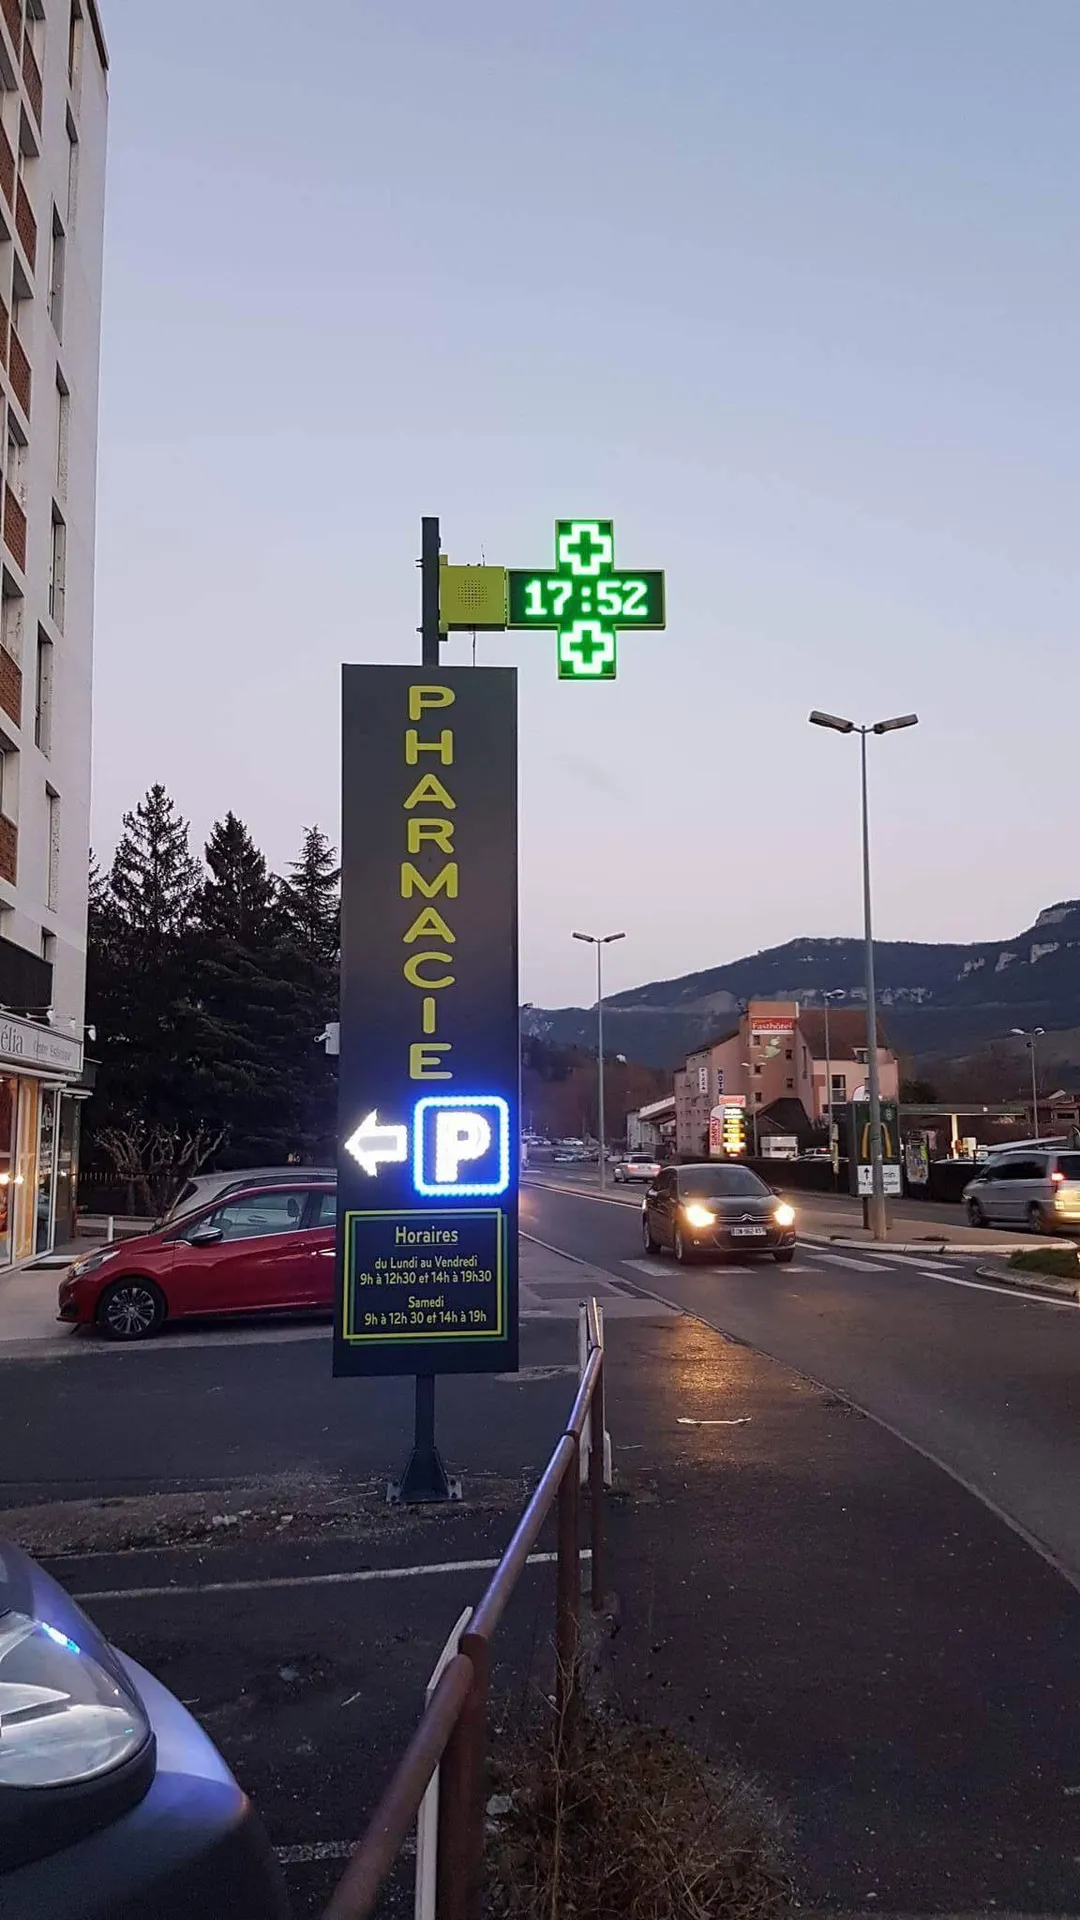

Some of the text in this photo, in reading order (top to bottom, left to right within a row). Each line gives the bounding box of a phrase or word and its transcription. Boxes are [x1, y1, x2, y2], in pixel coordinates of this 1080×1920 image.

[525, 580, 648, 616] 17:52
[400, 684, 459, 1080] PHARMACIE
[436, 1111, 491, 1182] P
[395, 1226, 458, 1244] Horaires
[375, 1255, 478, 1269] du Lundi au Vendredi
[360, 1270, 492, 1285] 9h à 12h30 et 14h à 19h30
[408, 1296, 444, 1308] Samedi
[364, 1310, 487, 1325] 9h à 12h 30 et 14h à 19h
